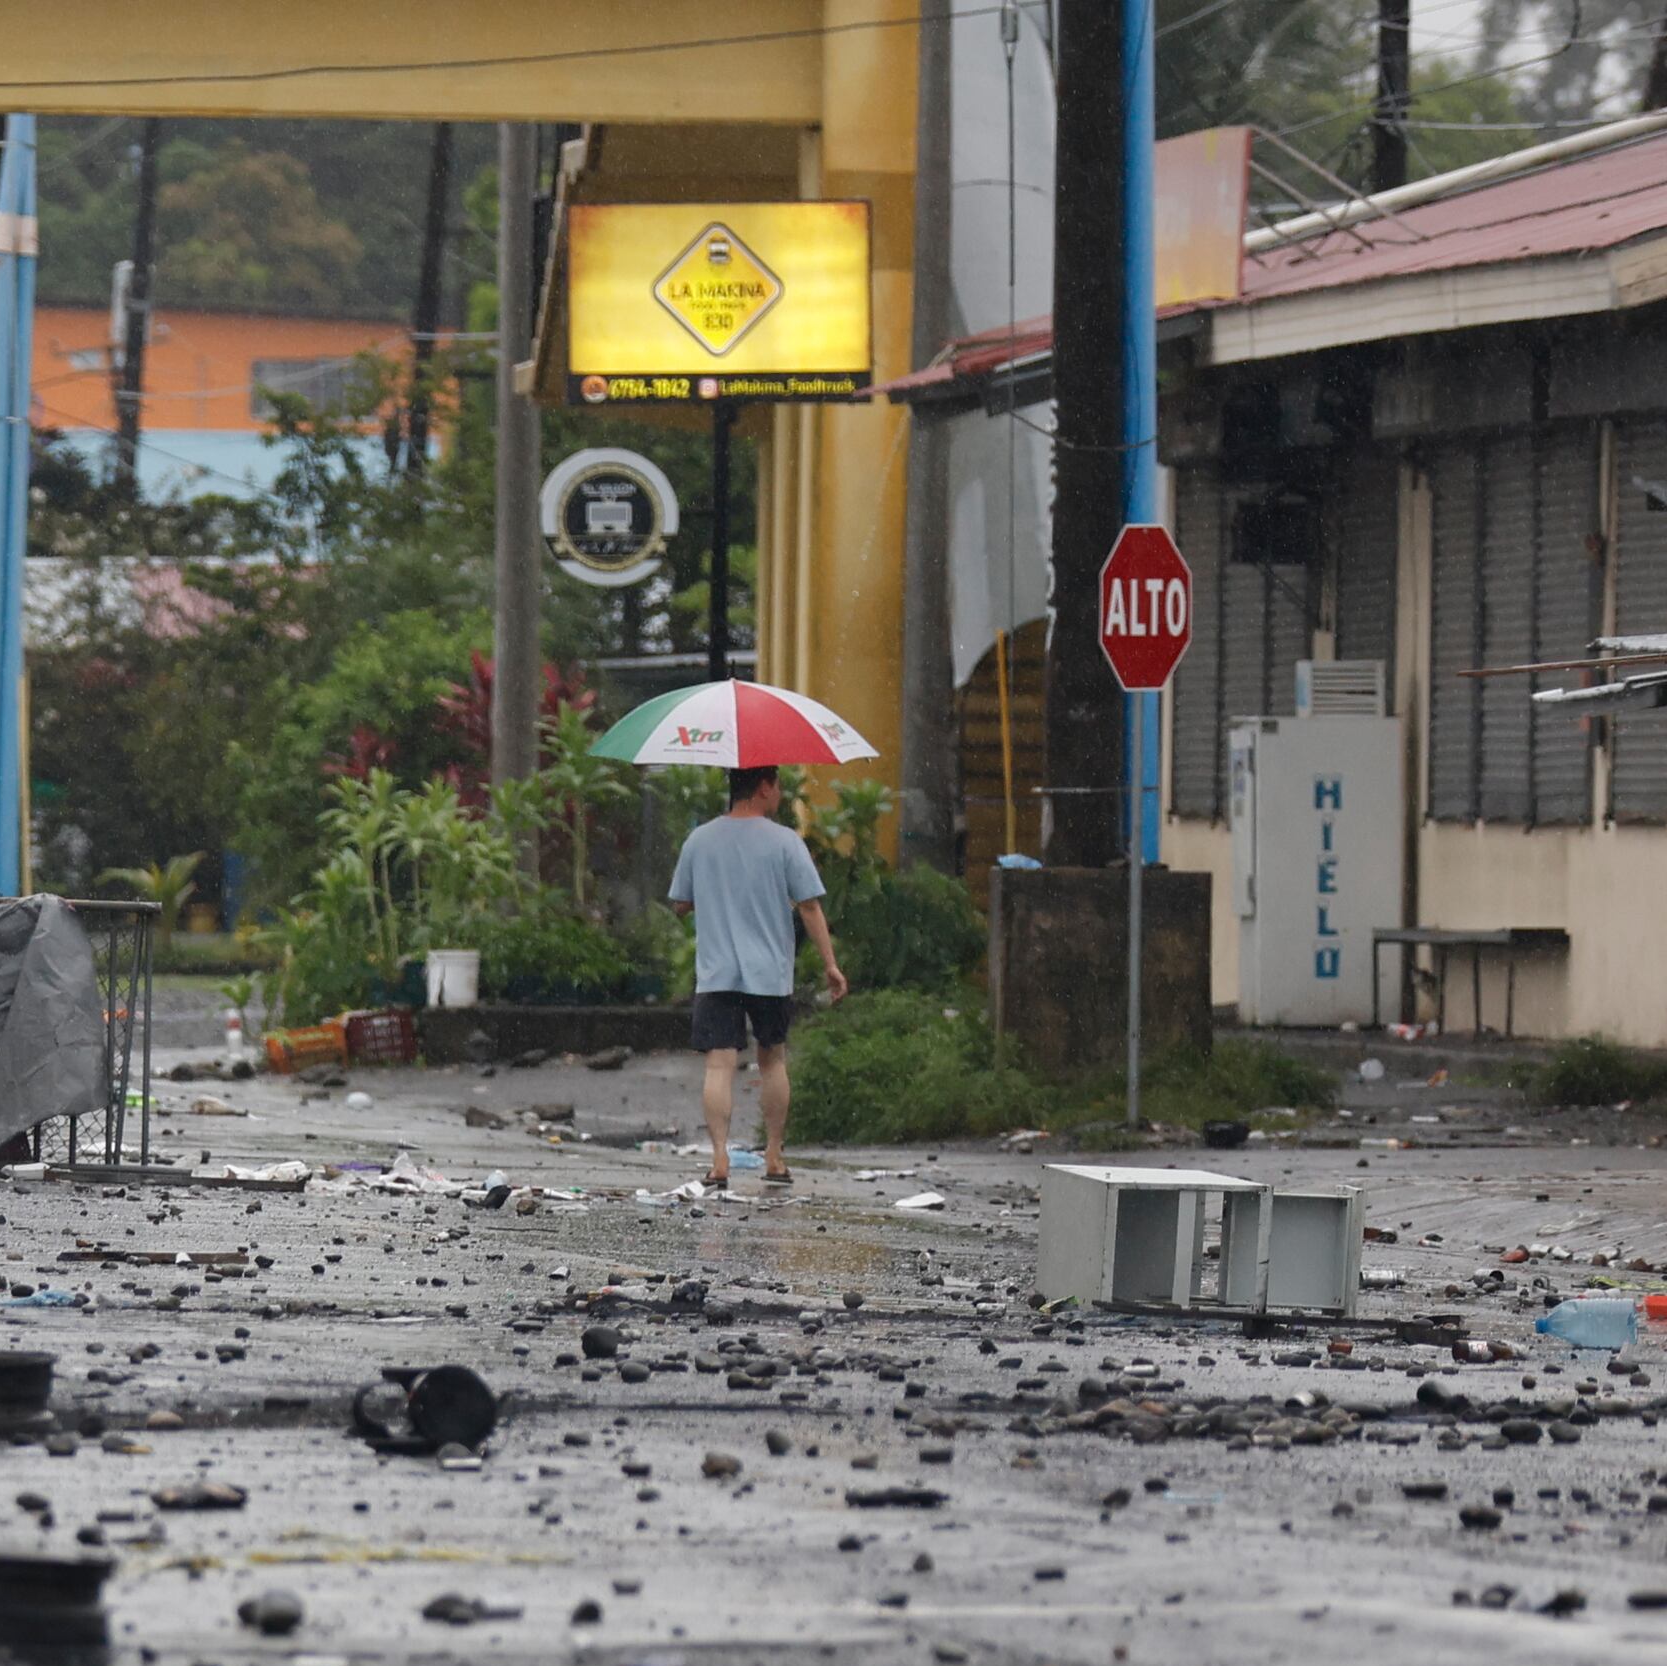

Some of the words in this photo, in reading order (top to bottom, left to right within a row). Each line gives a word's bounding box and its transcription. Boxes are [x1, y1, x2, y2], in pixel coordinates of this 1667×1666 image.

[668, 281, 692, 299] LA
[696, 281, 766, 299] MAKINA
[1104, 577, 1187, 637] ALTO
[668, 725, 725, 746] Xtra
[1313, 774, 1343, 979] HIELO
